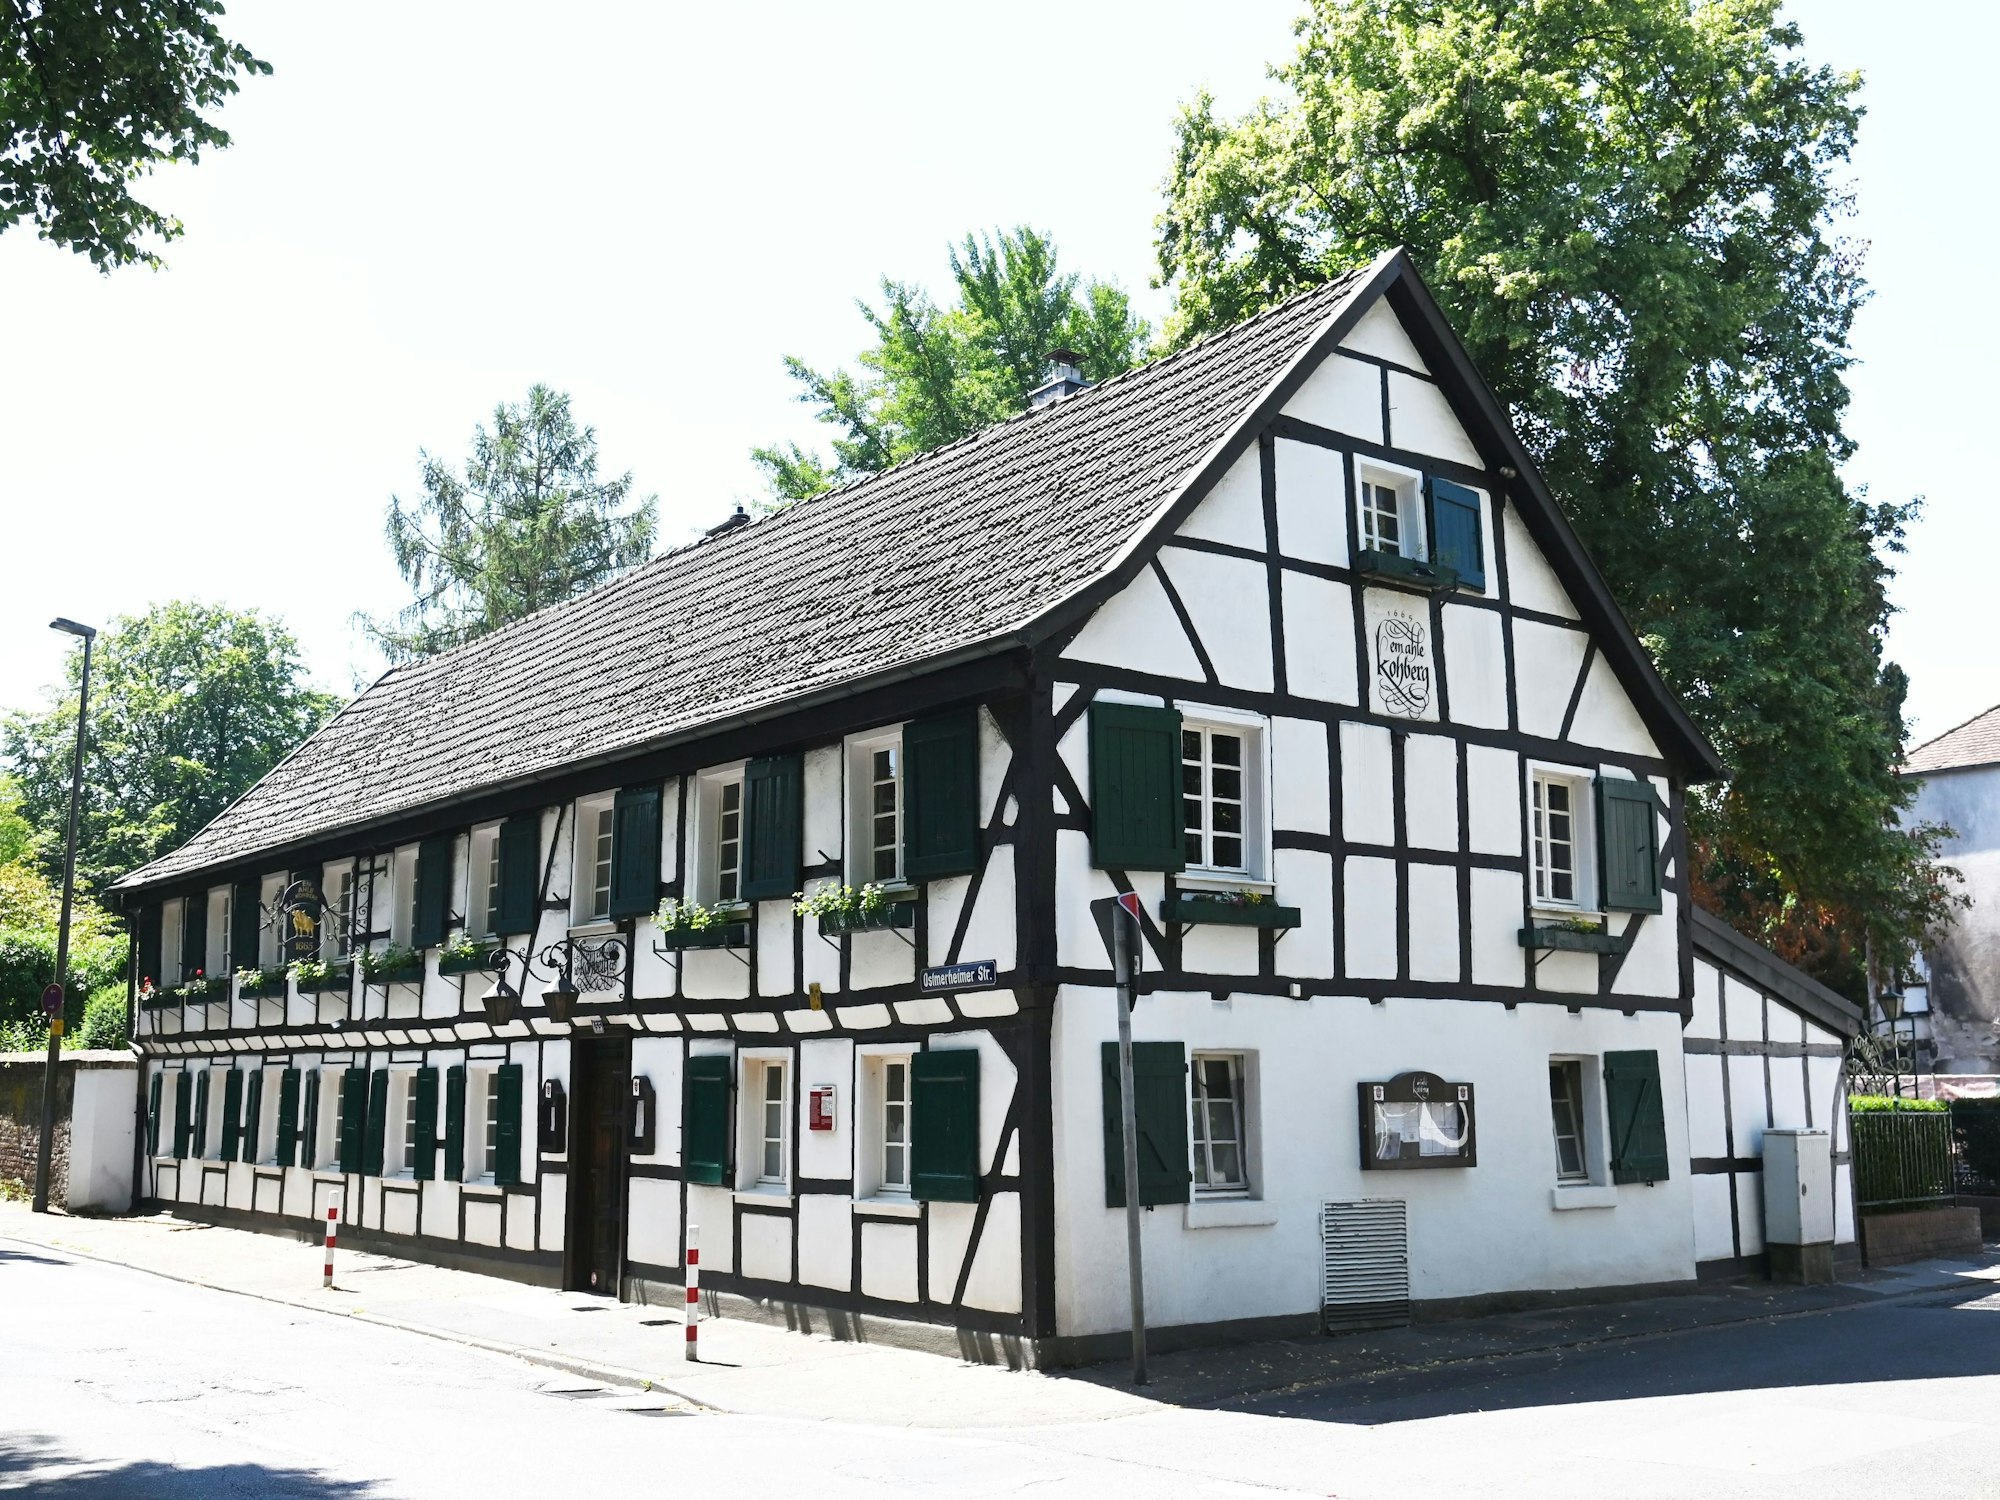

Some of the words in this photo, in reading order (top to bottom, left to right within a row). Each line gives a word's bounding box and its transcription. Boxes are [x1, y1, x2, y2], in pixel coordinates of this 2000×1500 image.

[1387, 609, 1413, 621] 1665
[1377, 654, 1430, 688] Kohberg
[295, 941, 314, 951] 1665
[923, 968, 975, 988] Ostmerheimer
[977, 965, 993, 982] Str.
